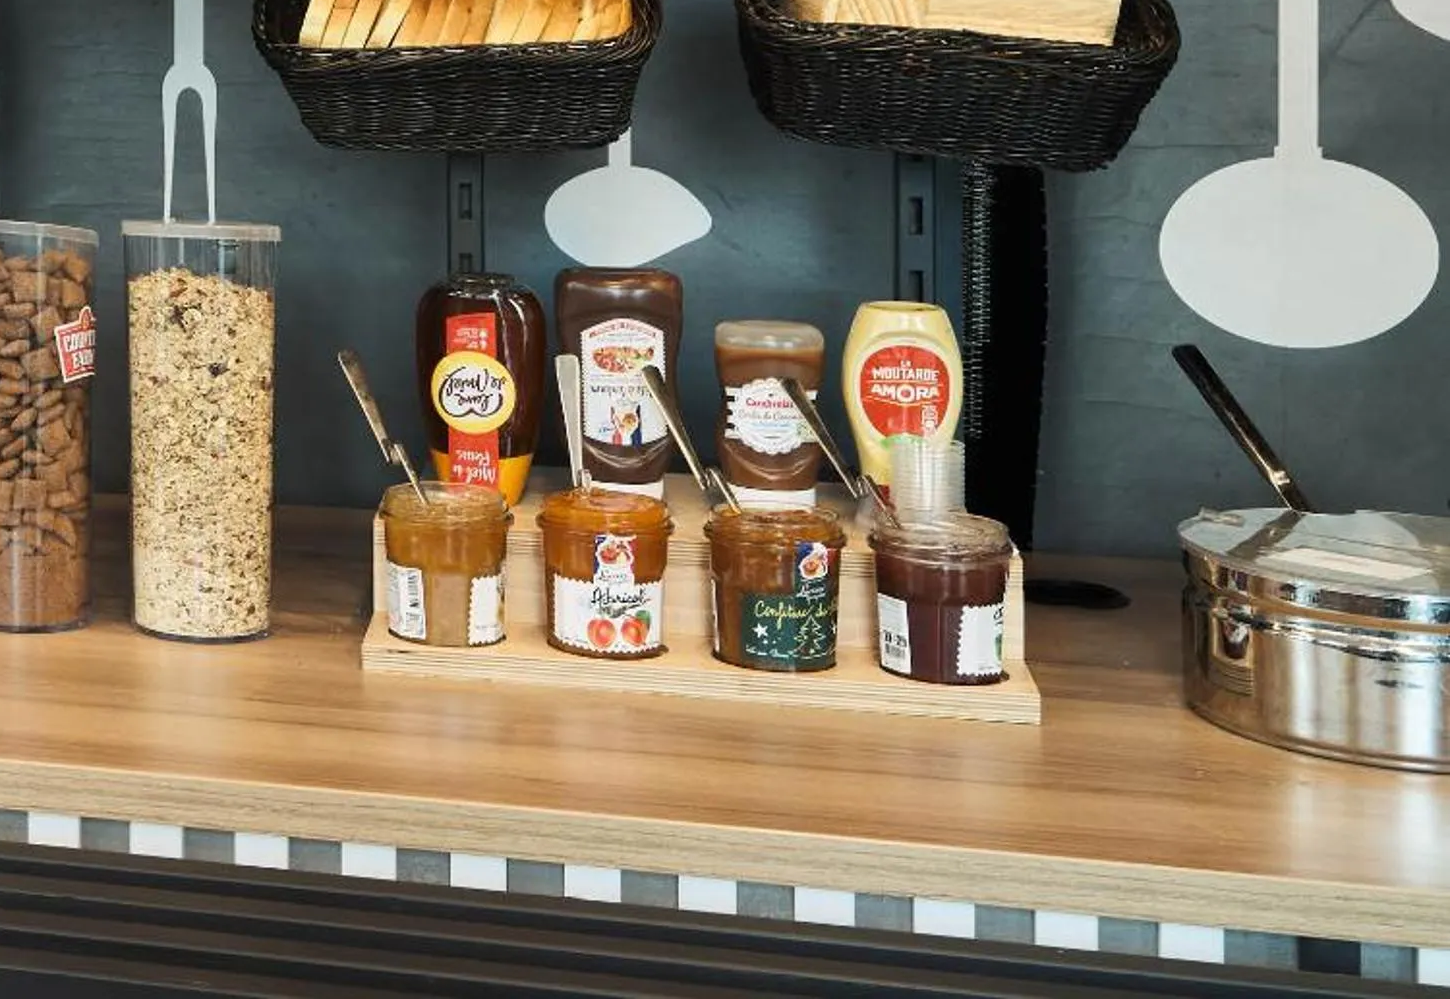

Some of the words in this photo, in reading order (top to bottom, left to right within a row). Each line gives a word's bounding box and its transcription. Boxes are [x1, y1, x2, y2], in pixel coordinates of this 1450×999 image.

[871, 366, 939, 381] MOUTARDE
[871, 383, 940, 403] AMORA
[465, 464, 496, 484] Miel
[591, 587, 647, 606] Abricot
